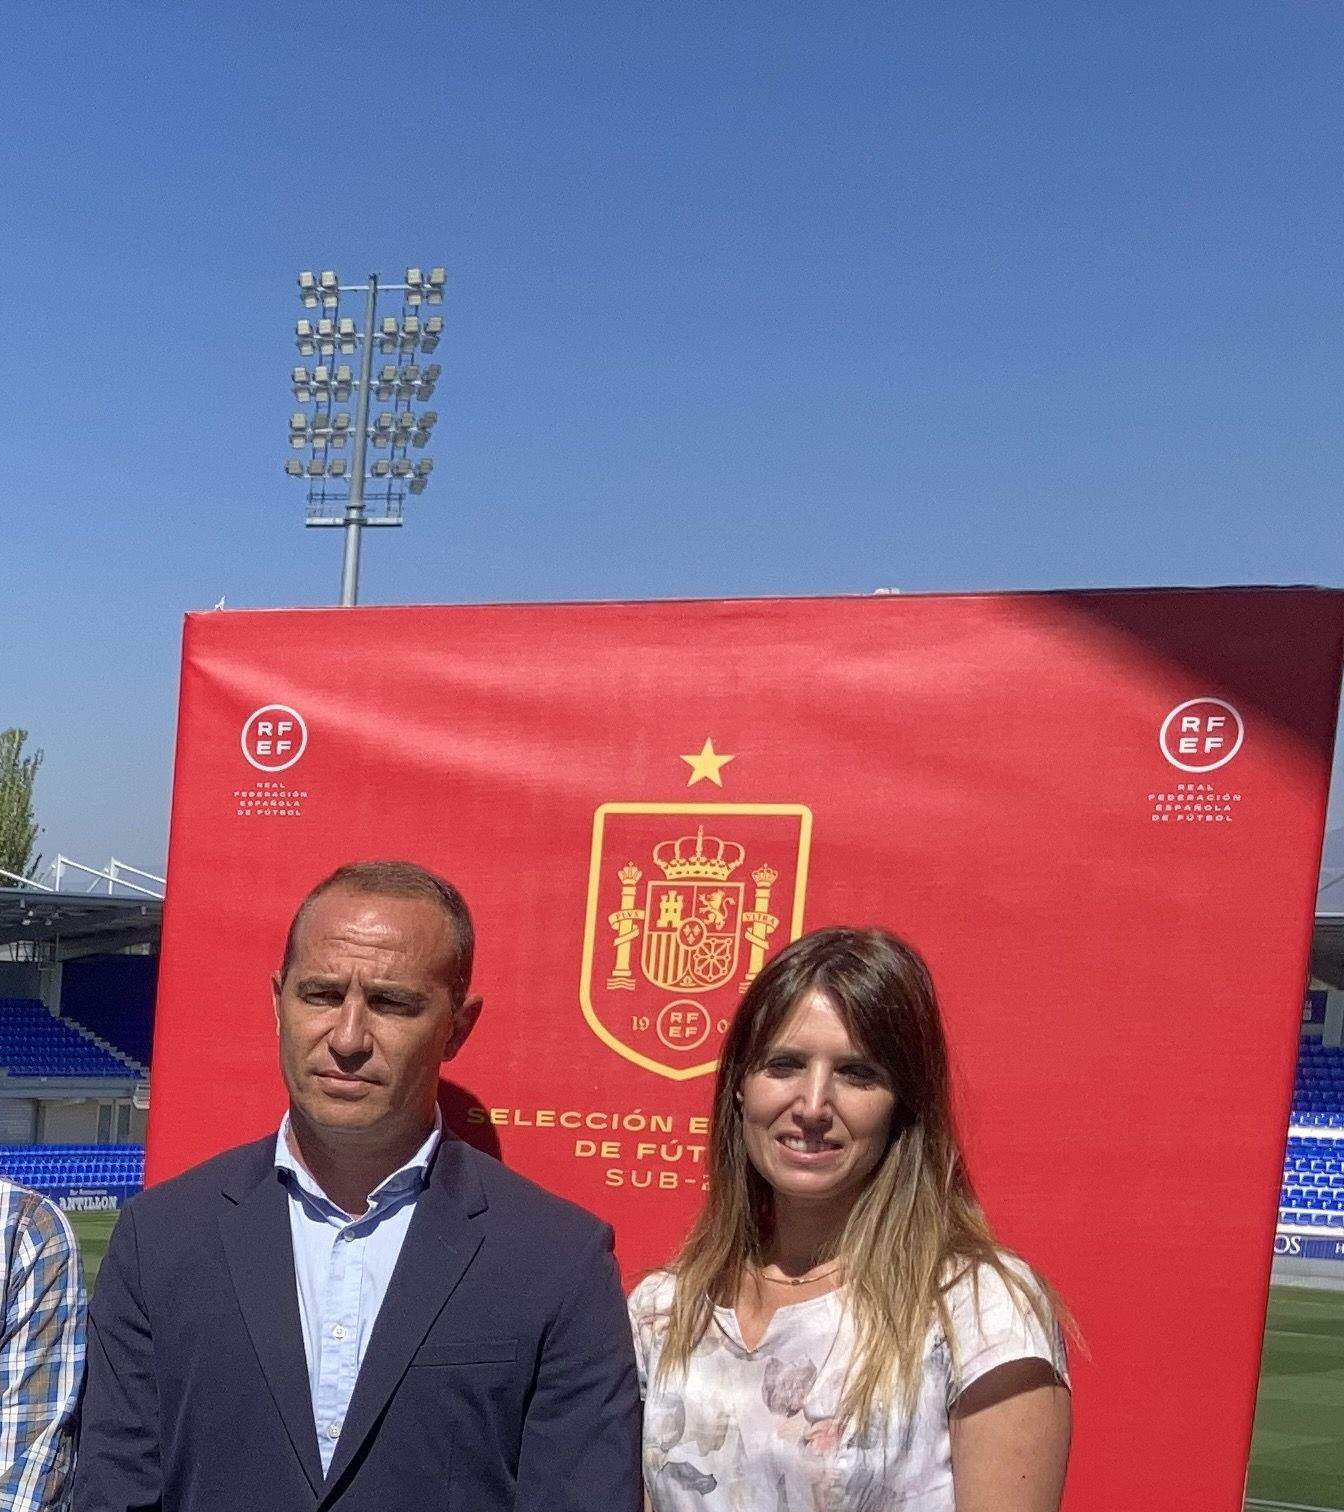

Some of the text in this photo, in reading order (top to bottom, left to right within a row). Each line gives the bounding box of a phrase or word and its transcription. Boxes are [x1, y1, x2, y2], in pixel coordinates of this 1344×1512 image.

[257, 721, 293, 737] RF
[1181, 716, 1226, 733] RF
[256, 740, 292, 755] EF
[1179, 737, 1224, 754] EF
[233, 790, 308, 798] FEDERACIÓN
[1148, 793, 1242, 802] FEDERACIÓN
[256, 808, 302, 816] FÚTBOL
[1155, 803, 1231, 812] ESPAÑOLA
[1177, 814, 1233, 822] FÚTBOL
[631, 1016, 650, 1032] 19
[670, 1012, 699, 1025] RF
[668, 1026, 698, 1038] EF
[467, 1108, 673, 1133] SELECCIÓN
[574, 1140, 622, 1159] DE
